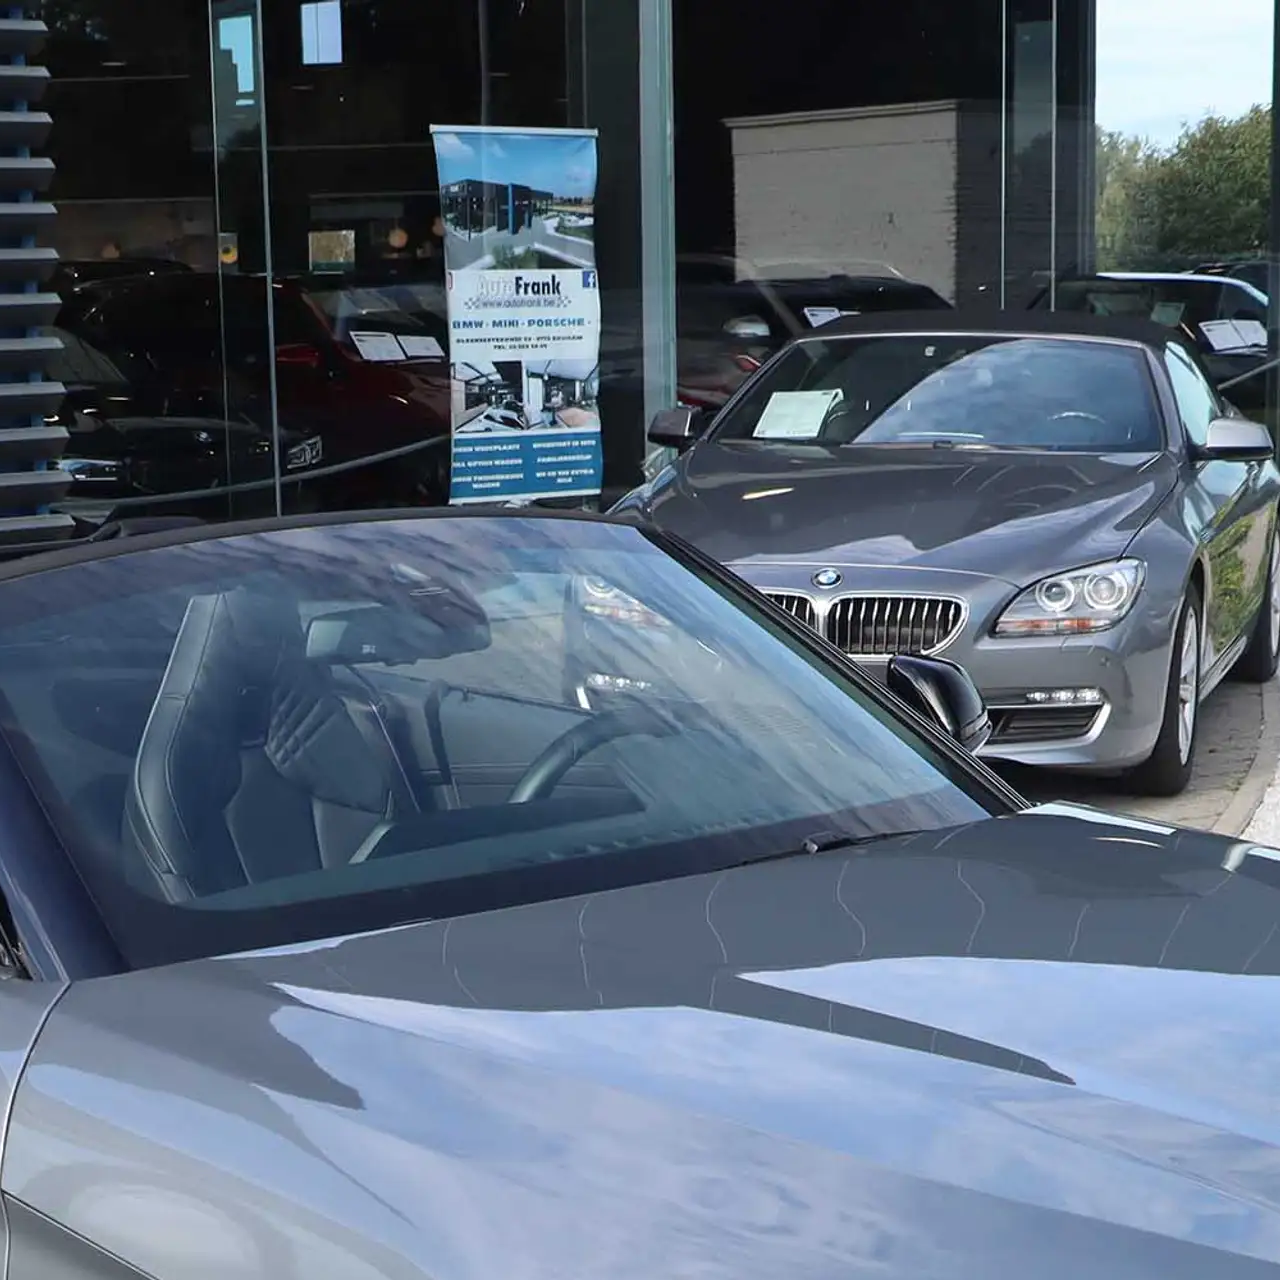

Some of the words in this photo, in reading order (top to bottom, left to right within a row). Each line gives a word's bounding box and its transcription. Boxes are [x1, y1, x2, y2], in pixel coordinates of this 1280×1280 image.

[452, 319, 484, 329] BMW
[491, 318, 519, 328] MINI
[527, 317, 585, 328] PORSCHE
